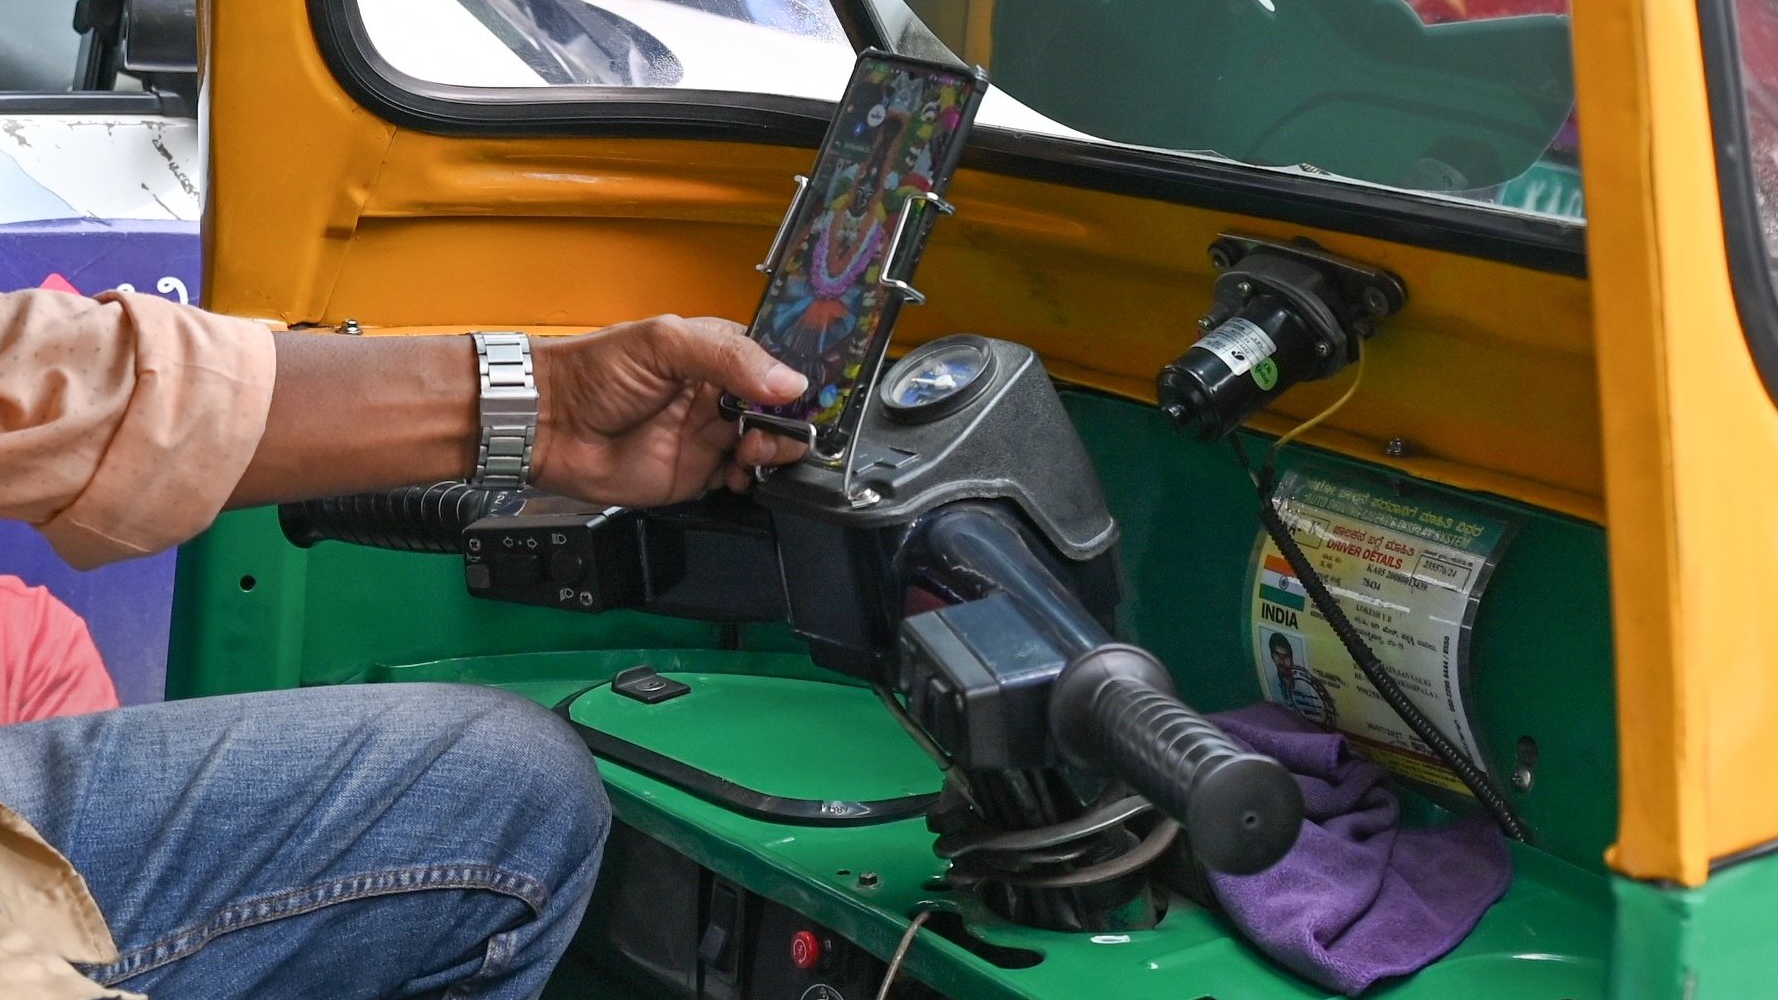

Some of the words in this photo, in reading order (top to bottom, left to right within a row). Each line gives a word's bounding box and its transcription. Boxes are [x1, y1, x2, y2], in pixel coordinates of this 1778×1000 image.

[1326, 539, 1362, 558] DRIVER
[1362, 549, 1403, 569] DETAILS
[1261, 602, 1298, 630] INDIA
